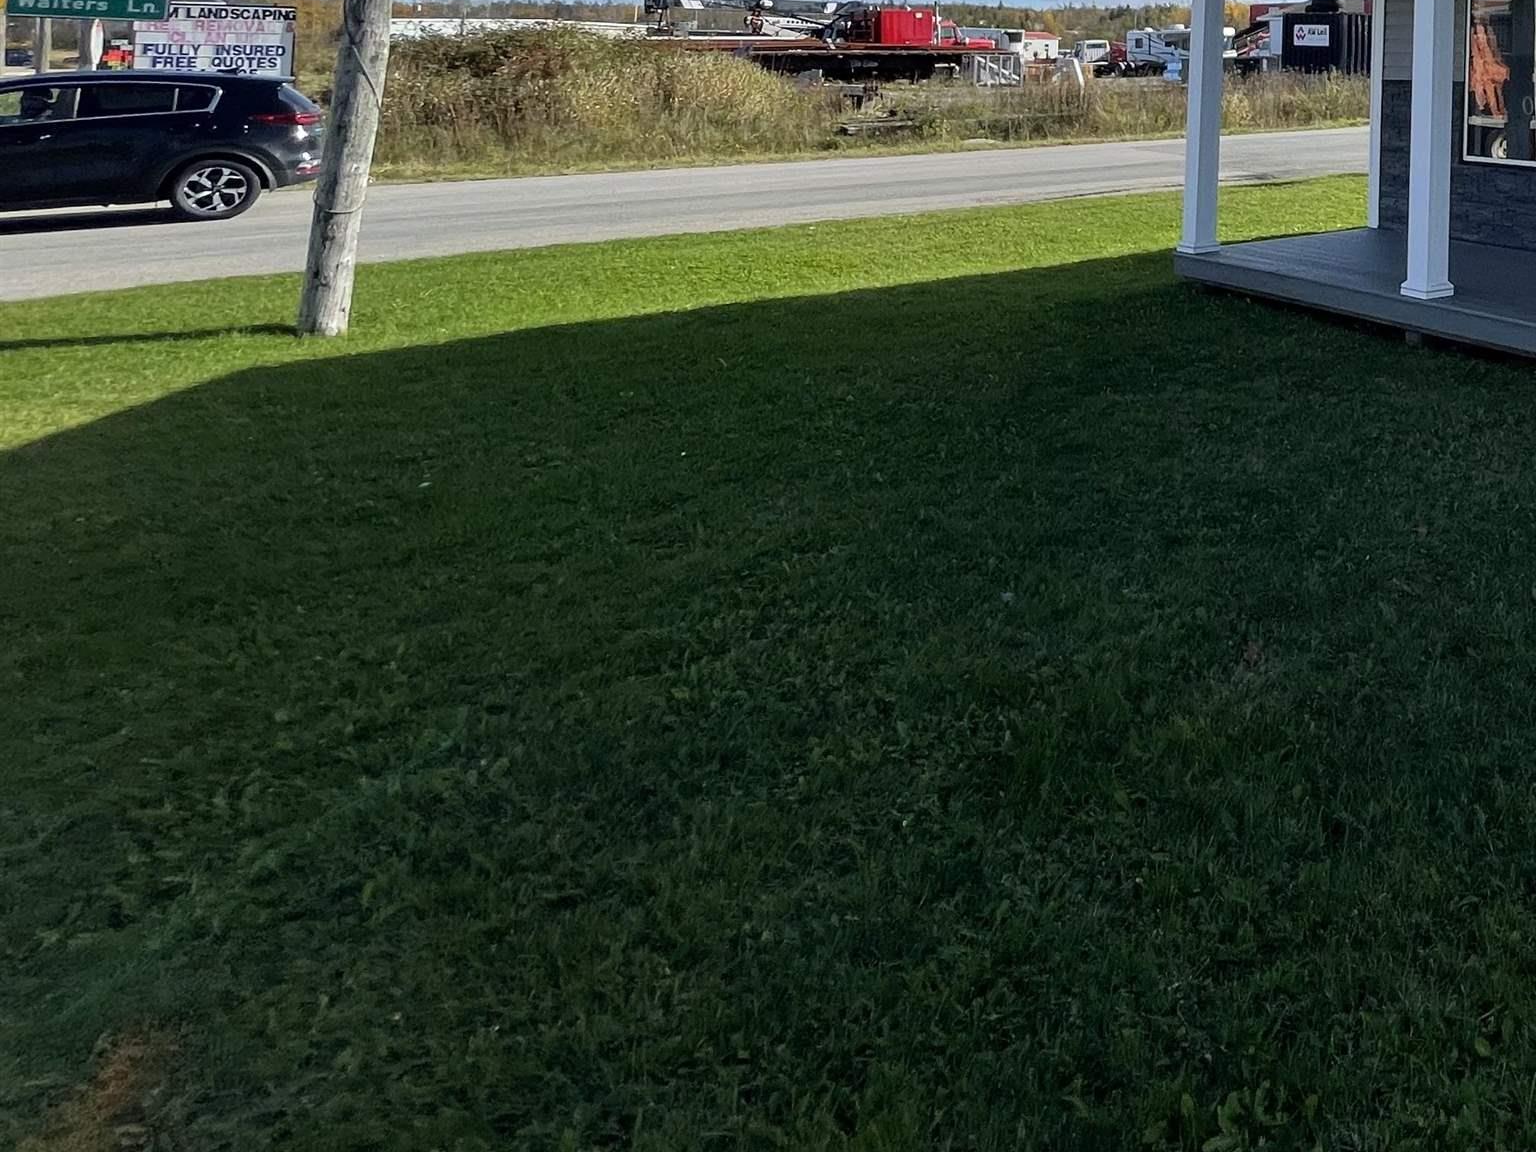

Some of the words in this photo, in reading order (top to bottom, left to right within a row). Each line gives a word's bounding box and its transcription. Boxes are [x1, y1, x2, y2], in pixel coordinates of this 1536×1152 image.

[186, 6, 296, 21] LANDSCAPING
[142, 43, 201, 56] FULLY
[215, 44, 286, 57] INSURED
[152, 56, 198, 68] FREE
[211, 57, 278, 69] QUOTES
